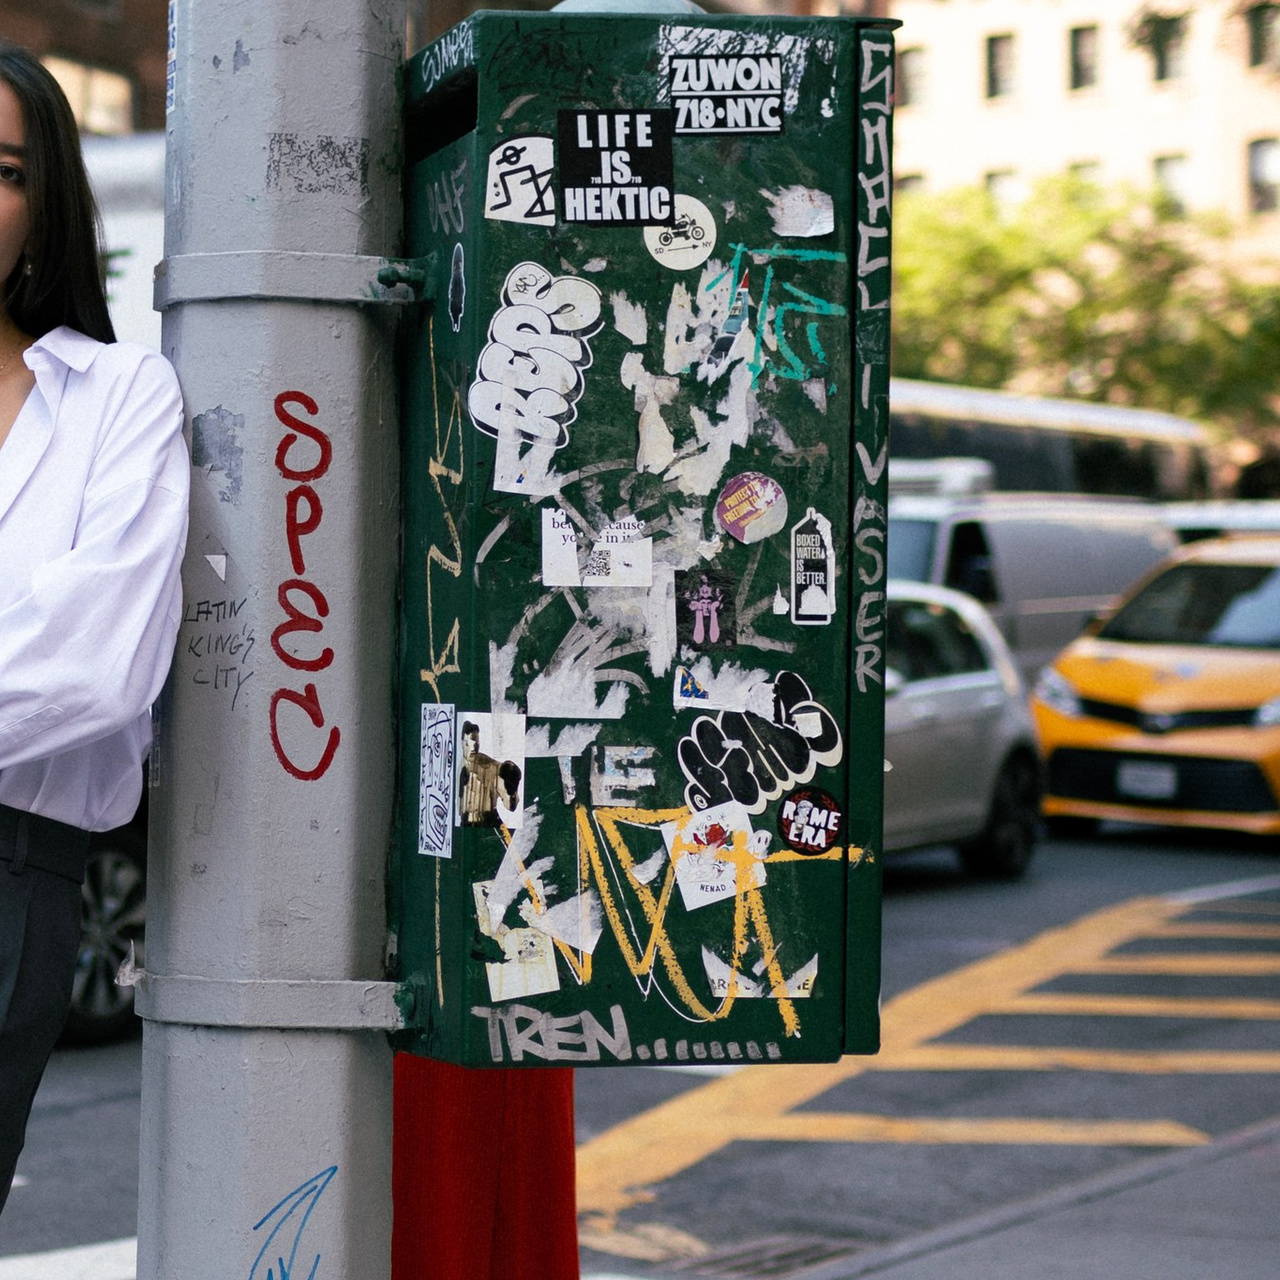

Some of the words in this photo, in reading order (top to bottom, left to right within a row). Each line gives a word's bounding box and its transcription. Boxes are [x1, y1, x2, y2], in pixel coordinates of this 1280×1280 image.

[671, 57, 781, 91] ZUWON
[577, 114, 653, 148] LIFE
[601, 150, 632, 184] IS
[565, 186, 671, 220] HEKTIC
[702, 240, 712, 248] NY
[606, 531, 618, 543] in
[796, 534, 820, 547] BOXED
[796, 547, 821, 559] WATER
[796, 559, 804, 572] IS
[183, 598, 247, 623] LATIN
[193, 664, 254, 711] CITY
[782, 800, 841, 831] RME
[789, 822, 826, 848] ERA
[700, 884, 726, 893] NENAD
